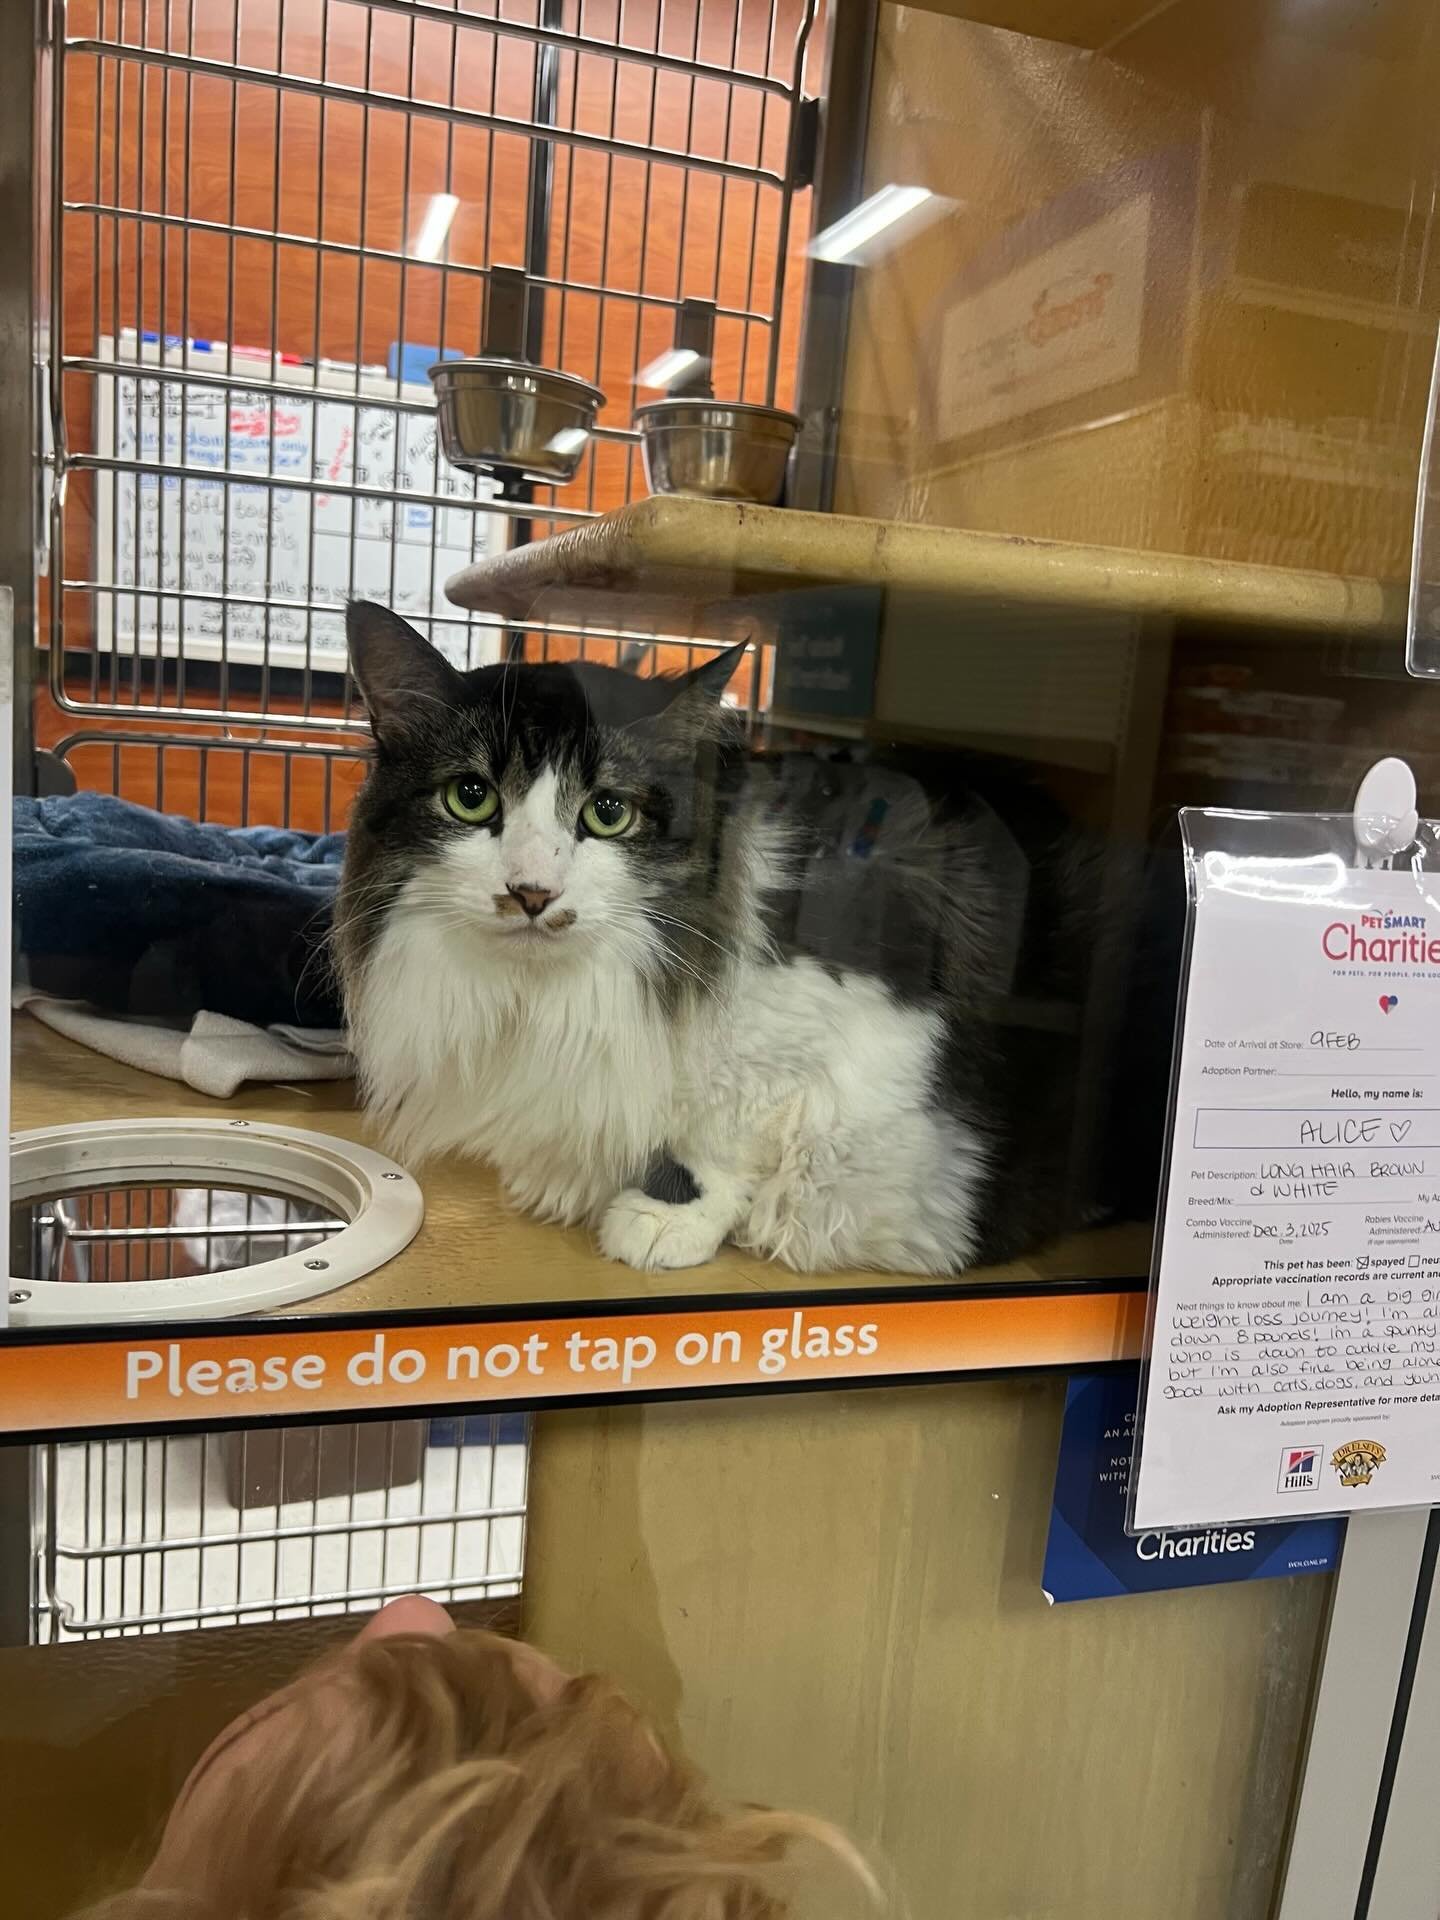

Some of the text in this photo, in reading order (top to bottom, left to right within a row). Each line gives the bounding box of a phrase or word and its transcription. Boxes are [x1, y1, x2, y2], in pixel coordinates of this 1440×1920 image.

[1361, 914, 1427, 929] PETSMART
[1204, 1039, 1304, 1050] Date of Arrival at Store:
[1201, 1066, 1278, 1076] Adoption Partner:
[1331, 1088, 1424, 1100] Hello, my name is:
[1300, 1117, 1382, 1145] ALICE
[1191, 1170, 1257, 1181] Pet Description:
[1260, 1160, 1425, 1180] LONG HAIR BROWN
[1273, 1181, 1339, 1198] WHITE
[1417, 1193, 1430, 1205] My
[1186, 1218, 1252, 1228] Combo Vaccine
[1193, 1229, 1250, 1240] Administered:
[1264, 1259, 1285, 1270] This
[1287, 1260, 1304, 1272] pet
[1306, 1260, 1324, 1269] has
[1370, 1257, 1405, 1269] spayed
[1212, 1275, 1273, 1288] Appropriate
[1275, 1272, 1332, 1284] vaccination
[1334, 1272, 1370, 1283] records
[1372, 1273, 1388, 1281] are
[1390, 1270, 1425, 1280] current
[1320, 1291, 1349, 1305] am
[1360, 1292, 1376, 1305] a
[1387, 1289, 1412, 1305] big
[1176, 1302, 1197, 1311] Neat
[1199, 1301, 1225, 1312] things
[1226, 1302, 1235, 1310] to
[1237, 1301, 1260, 1310] know
[1261, 1300, 1285, 1309] about
[1172, 1311, 1240, 1329] weight
[1247, 1312, 1283, 1327] loss
[1382, 1306, 1409, 1320] I'm
[1171, 1334, 1221, 1347] down
[1236, 1329, 1249, 1344] 8
[1362, 1327, 1374, 1338] a
[1383, 1324, 1437, 1339] spunky
[126, 1311, 879, 1399] Please do not tap on glass
[1170, 1341, 1435, 1363] who is down to cuddle my
[1168, 1365, 1201, 1382] but
[1211, 1363, 1239, 1377] I'm
[1251, 1361, 1289, 1377] also
[1300, 1359, 1336, 1375] fine
[1345, 1357, 1392, 1371] being
[1163, 1384, 1204, 1400] good
[1218, 1381, 1261, 1397] with
[1364, 1375, 1393, 1387] and
[1217, 1404, 1236, 1416] Ask
[1238, 1405, 1255, 1416] my
[1256, 1401, 1303, 1414] Adoption
[1304, 1396, 1376, 1412] Representative
[1378, 1395, 1392, 1405] for
[1394, 1395, 1418, 1404] more
[1104, 1428, 1120, 1439] AN
[1099, 1471, 1127, 1482] WITH
[1136, 1528, 1256, 1561] Charities
